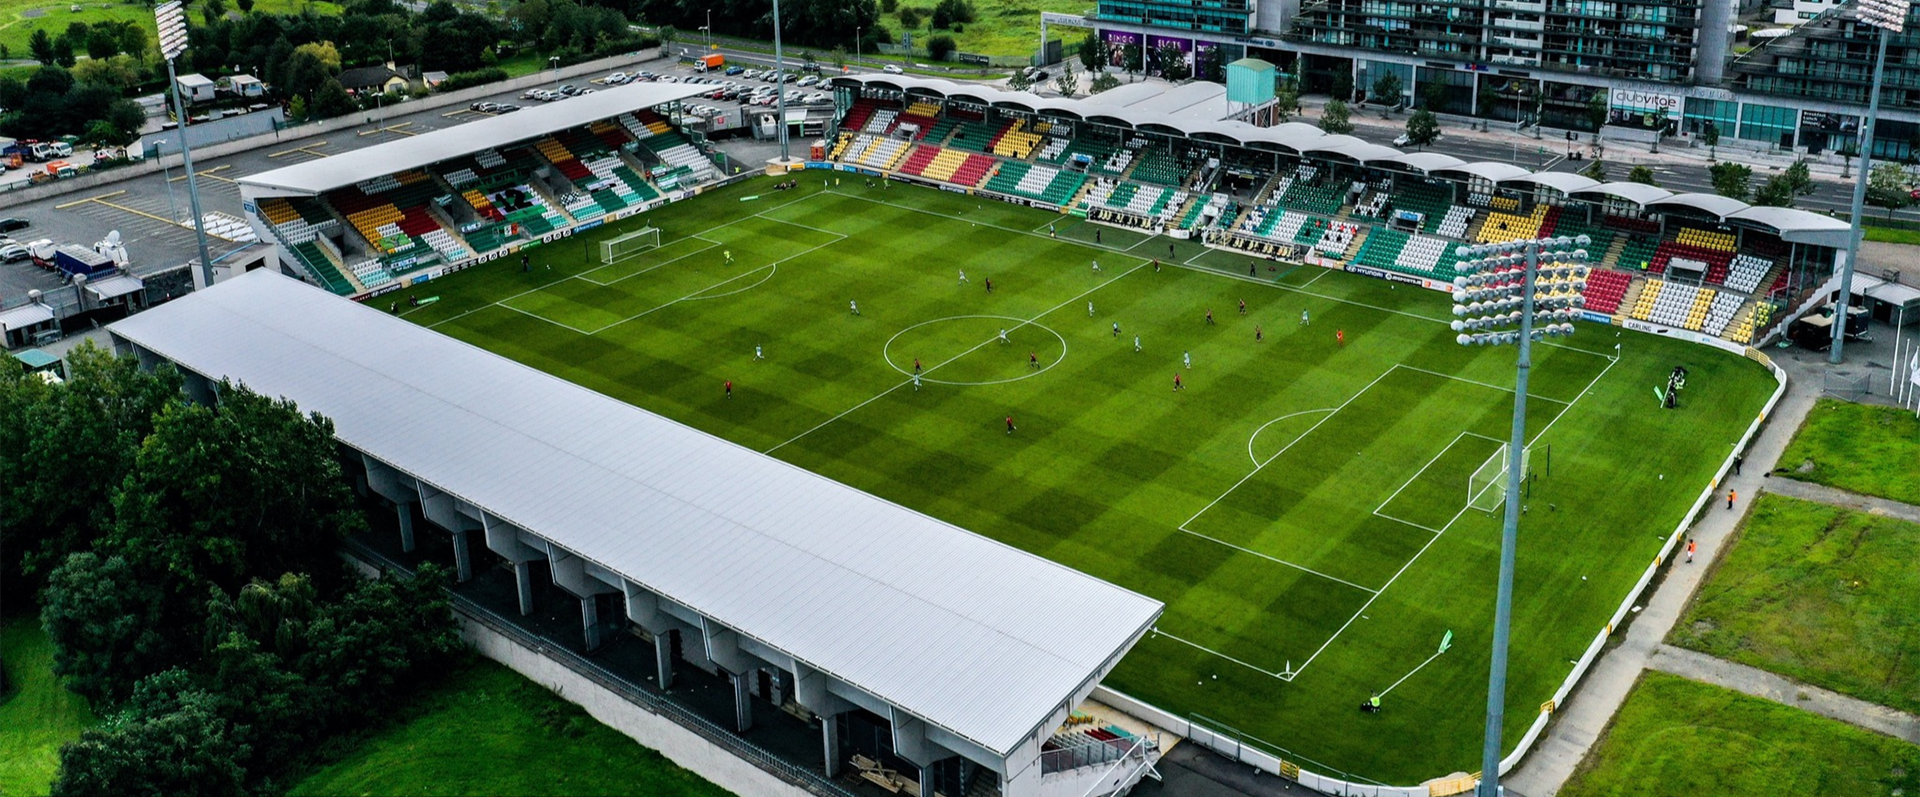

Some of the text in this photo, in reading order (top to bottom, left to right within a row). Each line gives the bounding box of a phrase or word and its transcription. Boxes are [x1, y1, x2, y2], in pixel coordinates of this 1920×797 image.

[1108, 34, 1135, 44] BINGO
[495, 189, 533, 213] 12
[1357, 268, 1384, 278] HYUNDAI
[1628, 321, 1652, 332] CARLING
